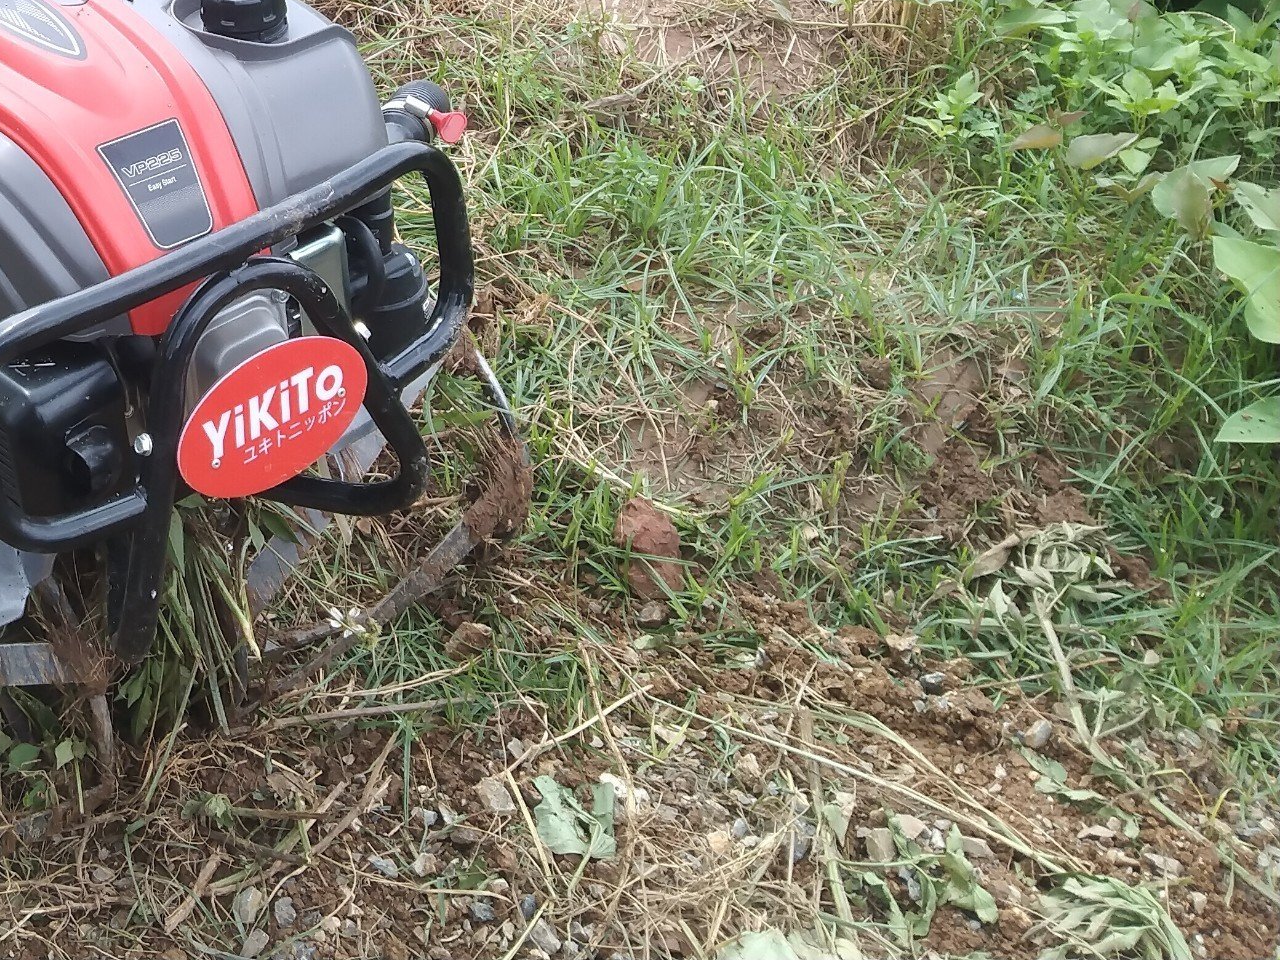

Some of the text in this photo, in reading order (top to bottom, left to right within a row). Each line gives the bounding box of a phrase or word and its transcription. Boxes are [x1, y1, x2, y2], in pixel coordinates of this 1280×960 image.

[121, 147, 183, 178] VP225
[147, 176, 177, 192] Easy Start
[243, 397, 347, 465] ユキトニッポン
